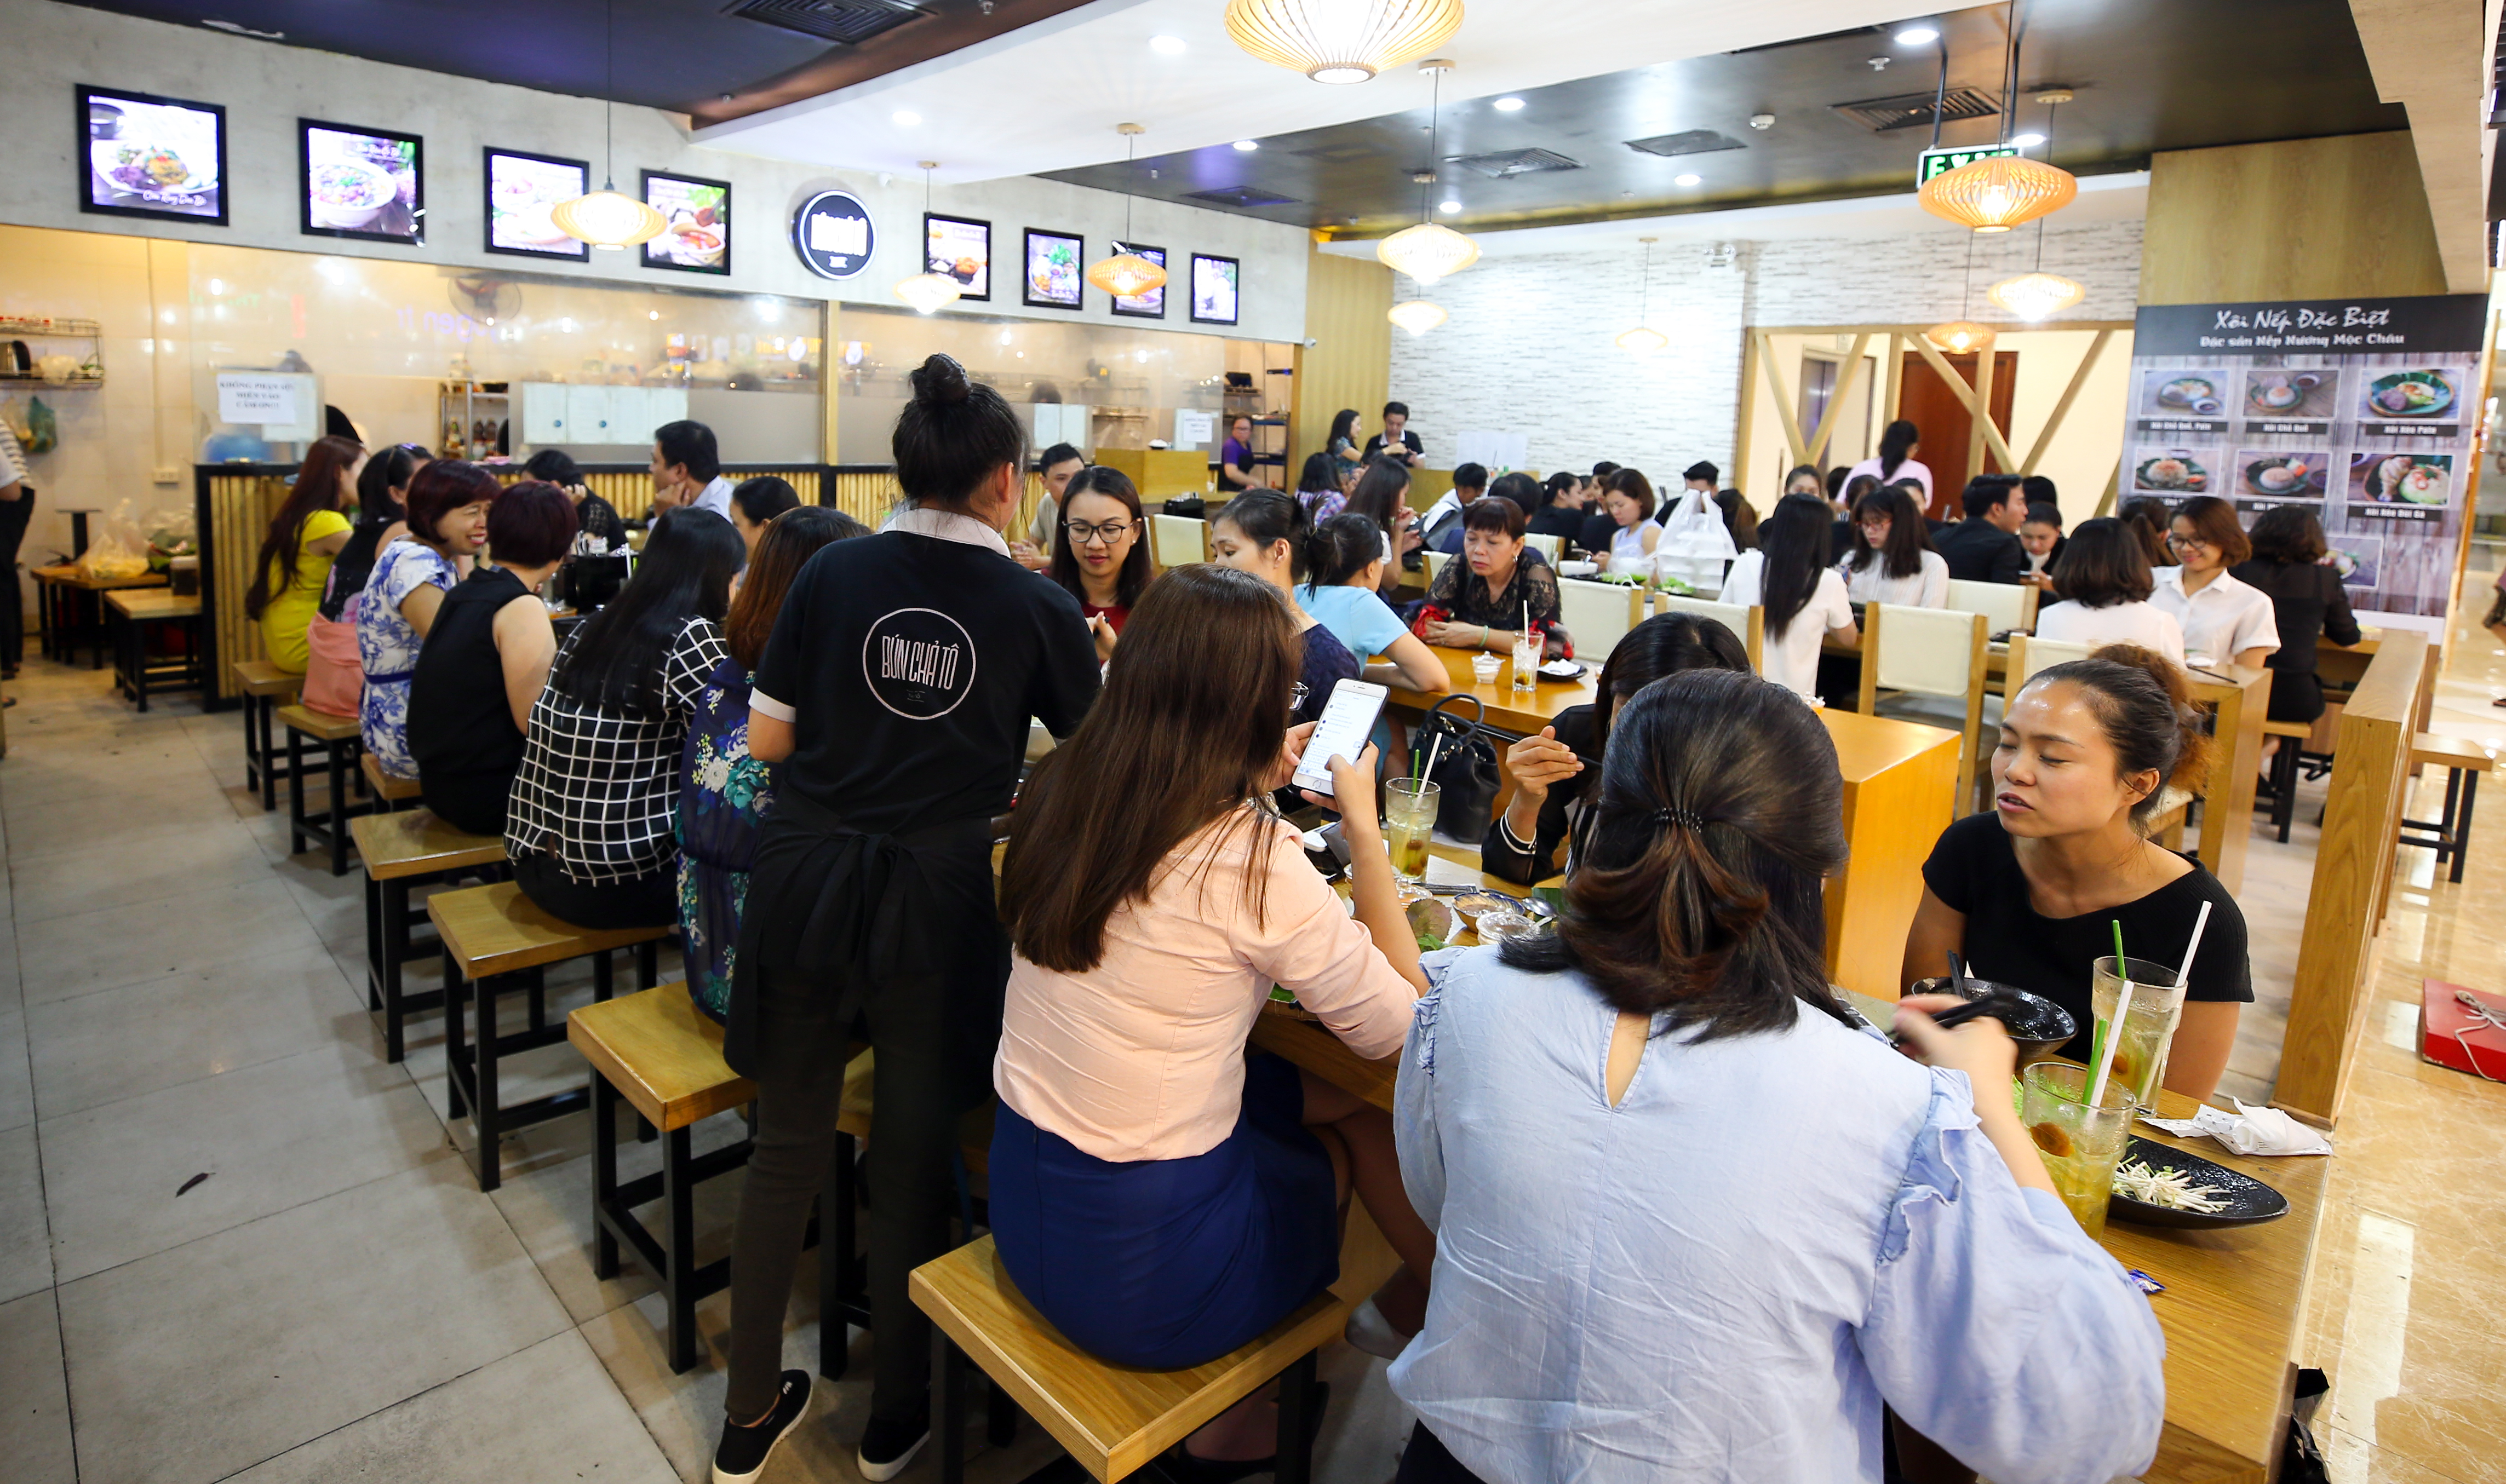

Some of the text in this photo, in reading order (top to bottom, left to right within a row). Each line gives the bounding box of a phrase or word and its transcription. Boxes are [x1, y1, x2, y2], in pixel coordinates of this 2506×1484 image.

[1927, 150, 2014, 180] EX
[2213, 306, 2390, 334] Xôi Nếp Đặc Biệt
[2333, 333, 2363, 346] Mộc
[2366, 332, 2405, 344] Châu
[881, 634, 960, 690] BÚN CHẢ TÔ
